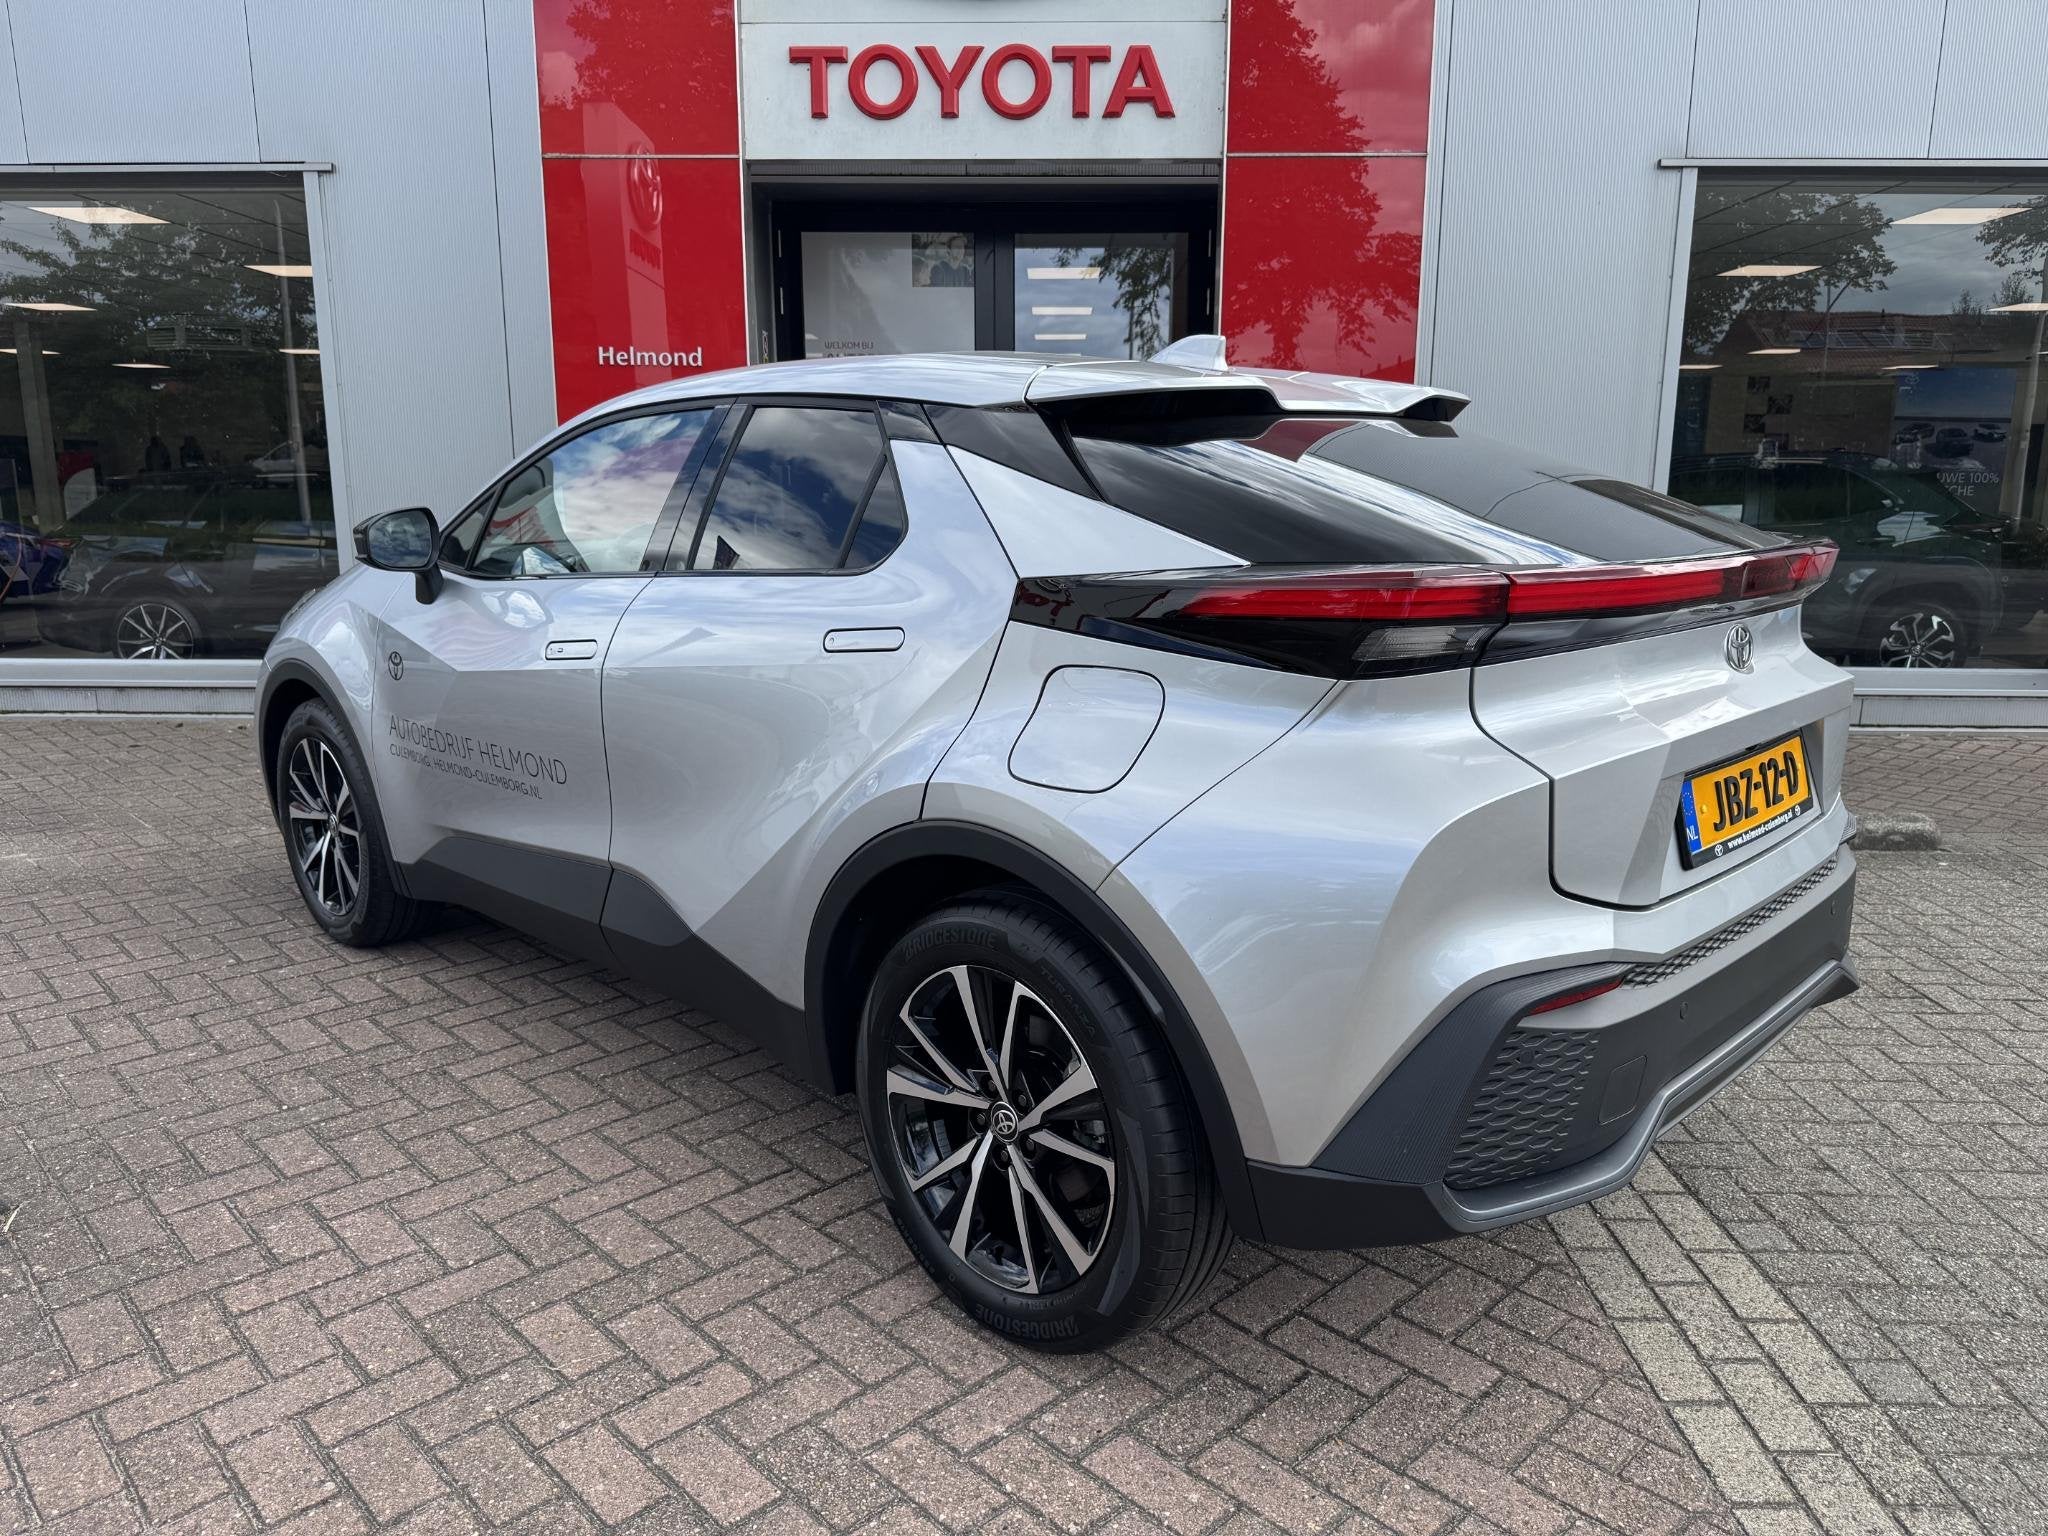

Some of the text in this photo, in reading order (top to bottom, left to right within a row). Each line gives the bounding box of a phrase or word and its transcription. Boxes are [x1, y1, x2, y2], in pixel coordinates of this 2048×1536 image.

[789, 43, 1176, 120] TOYOTA
[598, 346, 703, 367] Helmond
[1969, 472, 1999, 483] 100%
[389, 715, 567, 784] AUTOBEDRIJF HELMOND
[1713, 751, 1799, 832] JBZ-12-D
[1686, 827, 1698, 841] NL
[1727, 809, 1793, 849] www.helmond-culemborg.nl
[904, 927, 998, 959] BRIDGESTONE
[975, 1303, 1082, 1339] BRIDGESTONE
